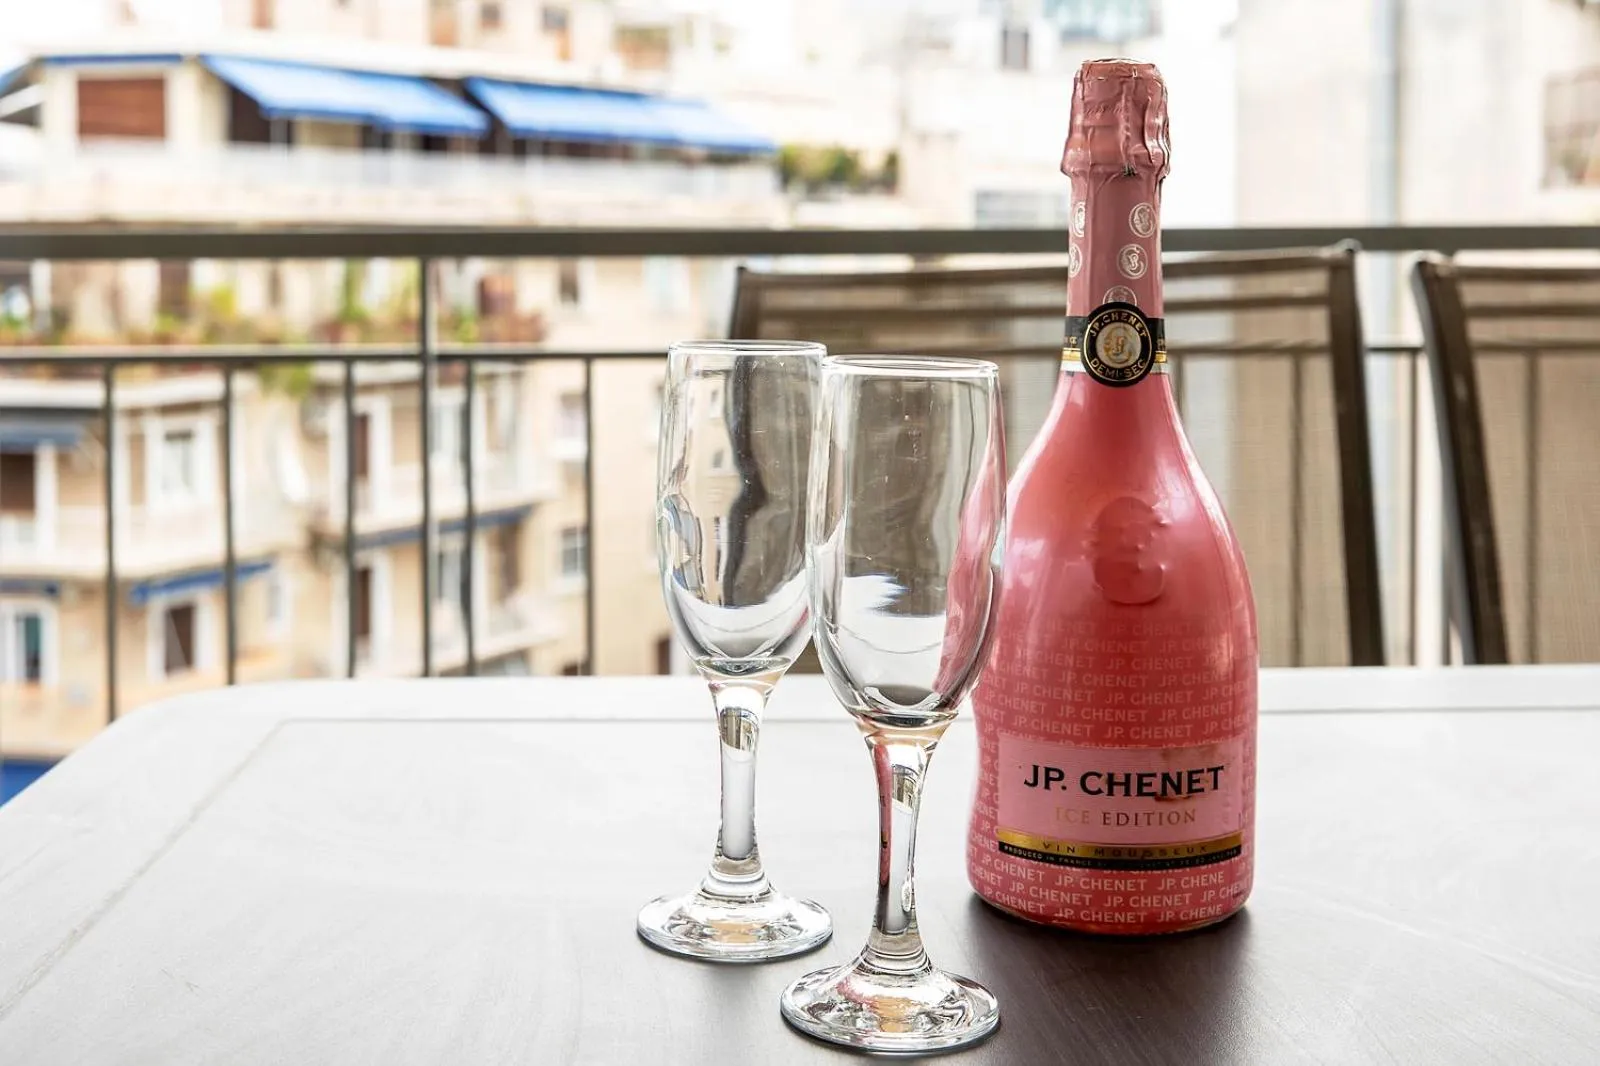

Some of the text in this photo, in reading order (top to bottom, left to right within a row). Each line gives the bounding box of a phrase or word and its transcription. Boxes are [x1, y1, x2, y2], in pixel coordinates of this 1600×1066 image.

[1082, 673, 1149, 688] CHENET
[1033, 684, 1096, 703] CHENET
[1130, 690, 1194, 706] CHENET
[1080, 707, 1149, 723] CHENET
[1182, 700, 1233, 720] CHENET
[1031, 718, 1095, 738] CHENET
[1129, 724, 1194, 740] CHENET
[1024, 765, 1067, 791] JP.
[1080, 766, 1225, 798] CHENET
[1056, 807, 1197, 827] ICE EDITION
[1043, 842, 1076, 855] VIN
[994, 858, 1045, 883] CHENET
[1080, 877, 1148, 892] CHENET
[995, 890, 1045, 915] CHENET
[1080, 909, 1148, 924] CHENET
[1029, 885, 1093, 907] CHENET
[1129, 892, 1193, 909] CHENET
